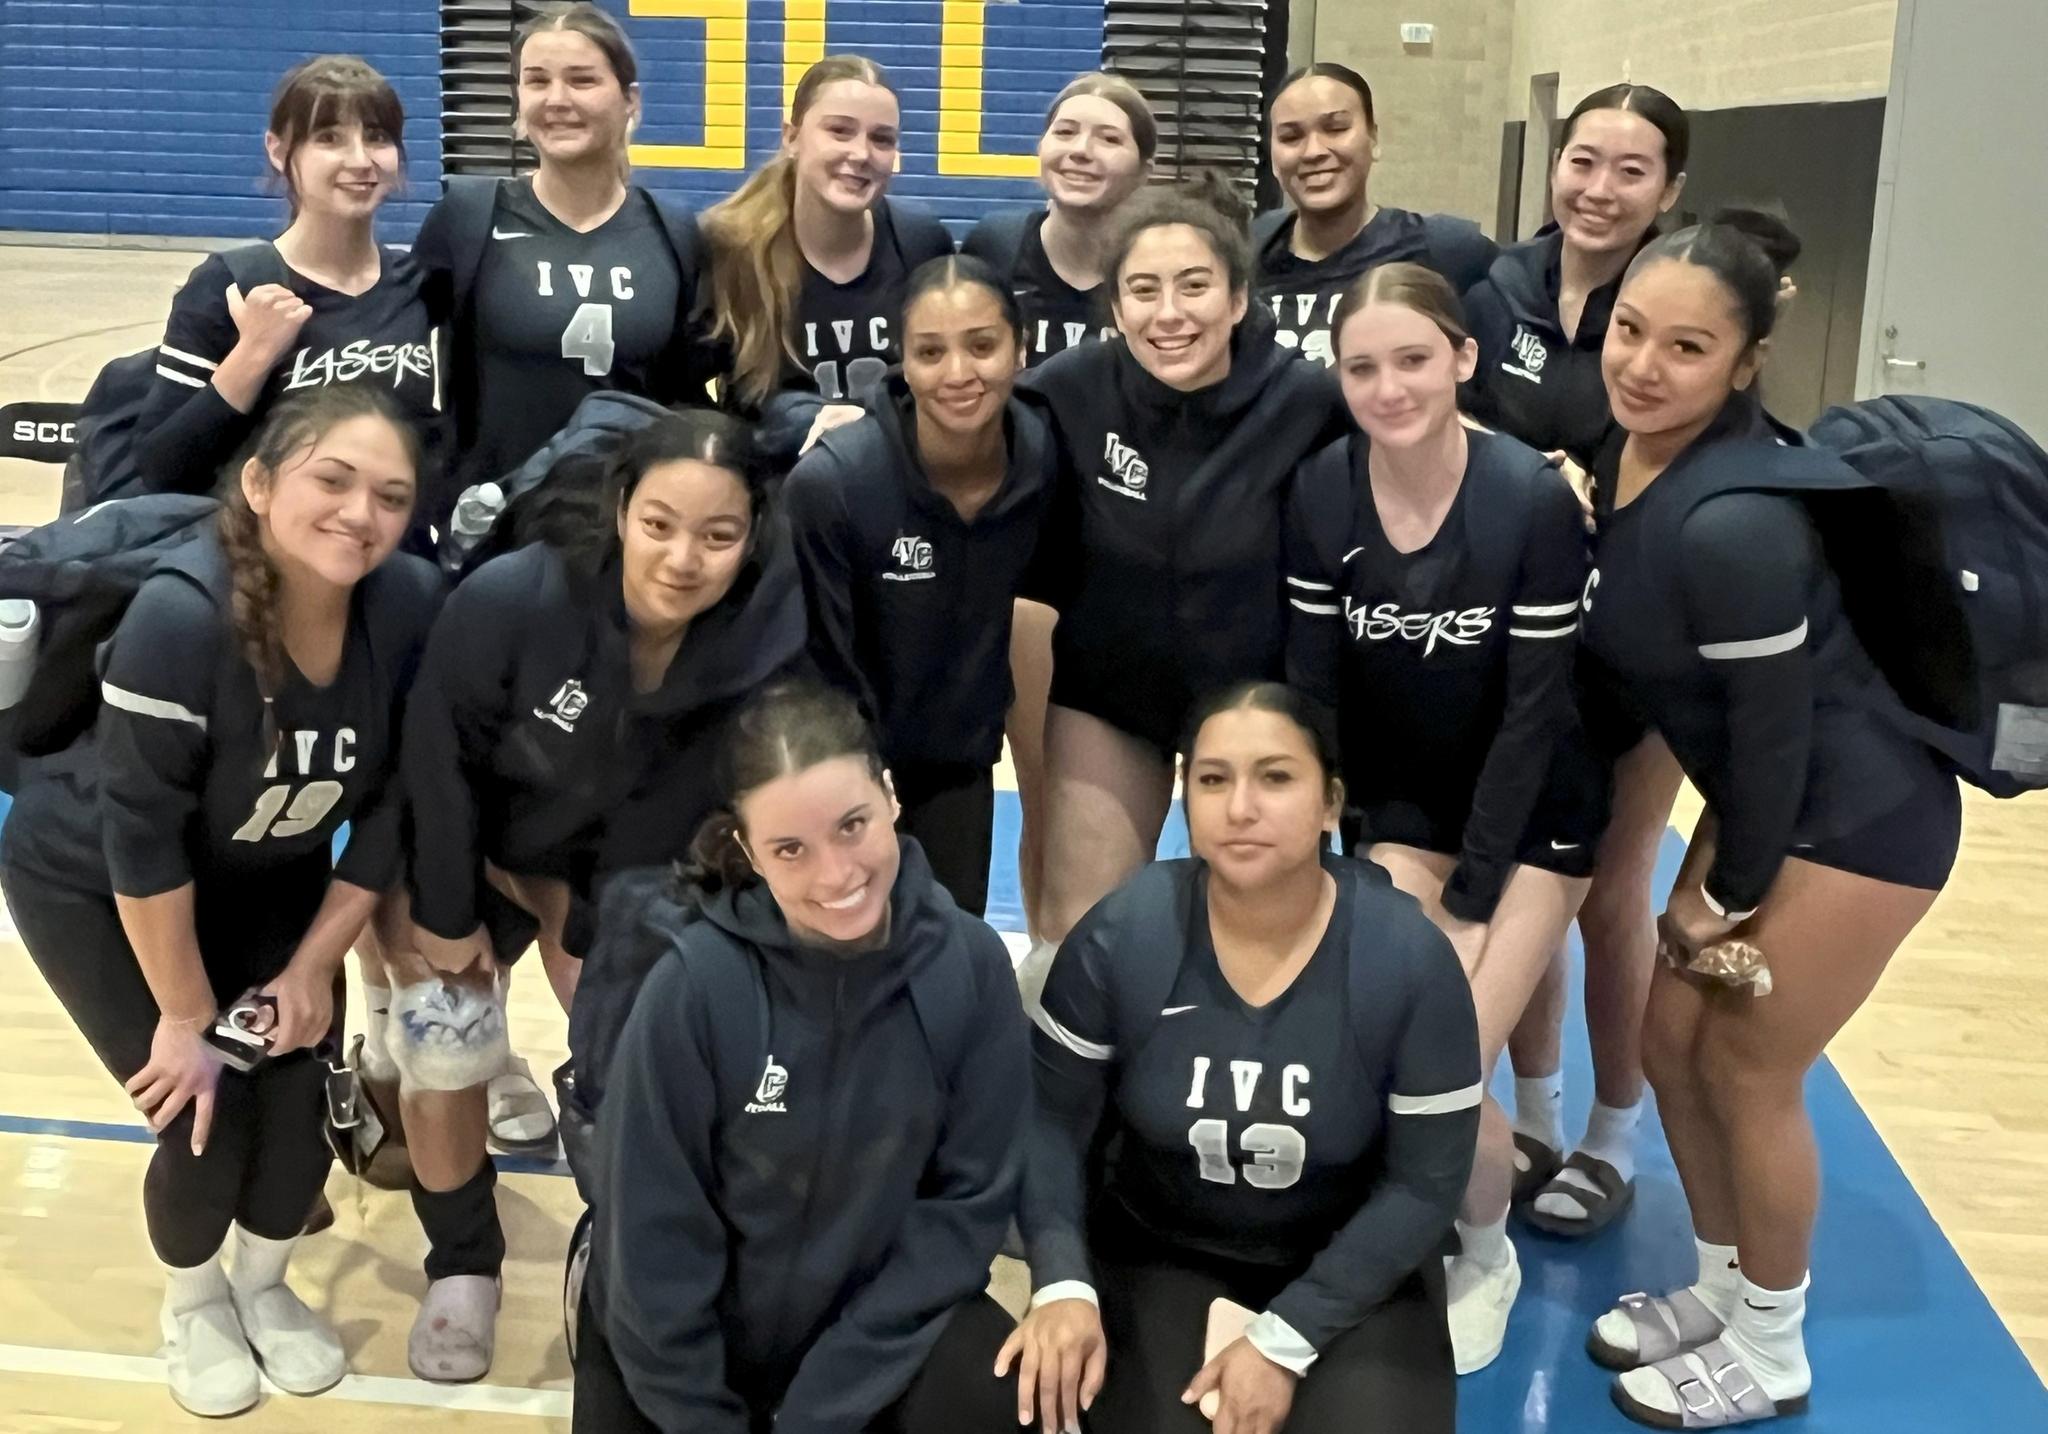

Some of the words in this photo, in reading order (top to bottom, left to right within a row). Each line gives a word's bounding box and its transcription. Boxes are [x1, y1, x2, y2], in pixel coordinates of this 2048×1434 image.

[537, 261, 634, 300] IVC
[561, 303, 615, 376] 4
[805, 316, 889, 356] IVC
[232, 780, 344, 843] 19
[1186, 1056, 1311, 1117] IVC
[1188, 1118, 1306, 1189] 13
